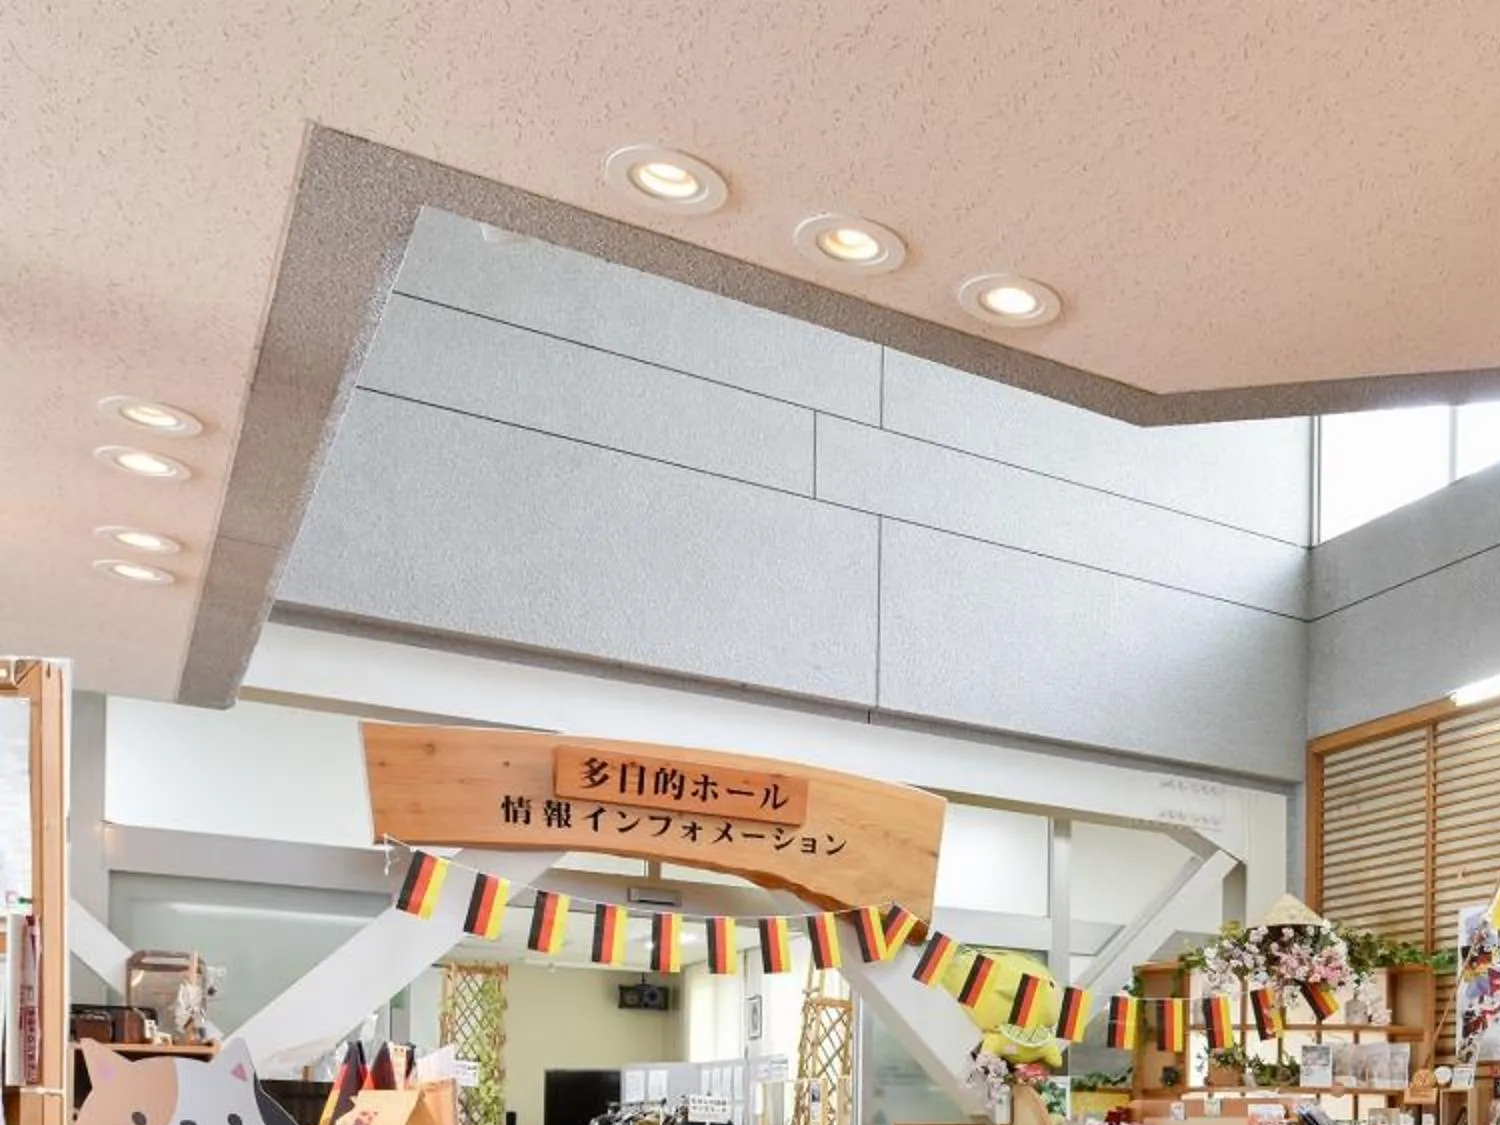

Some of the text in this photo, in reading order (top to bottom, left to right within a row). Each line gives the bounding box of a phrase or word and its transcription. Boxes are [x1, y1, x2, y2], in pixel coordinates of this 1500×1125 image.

[581, 756, 789, 811] 多目的ホール
[501, 795, 848, 857] 情報インフォメーション
